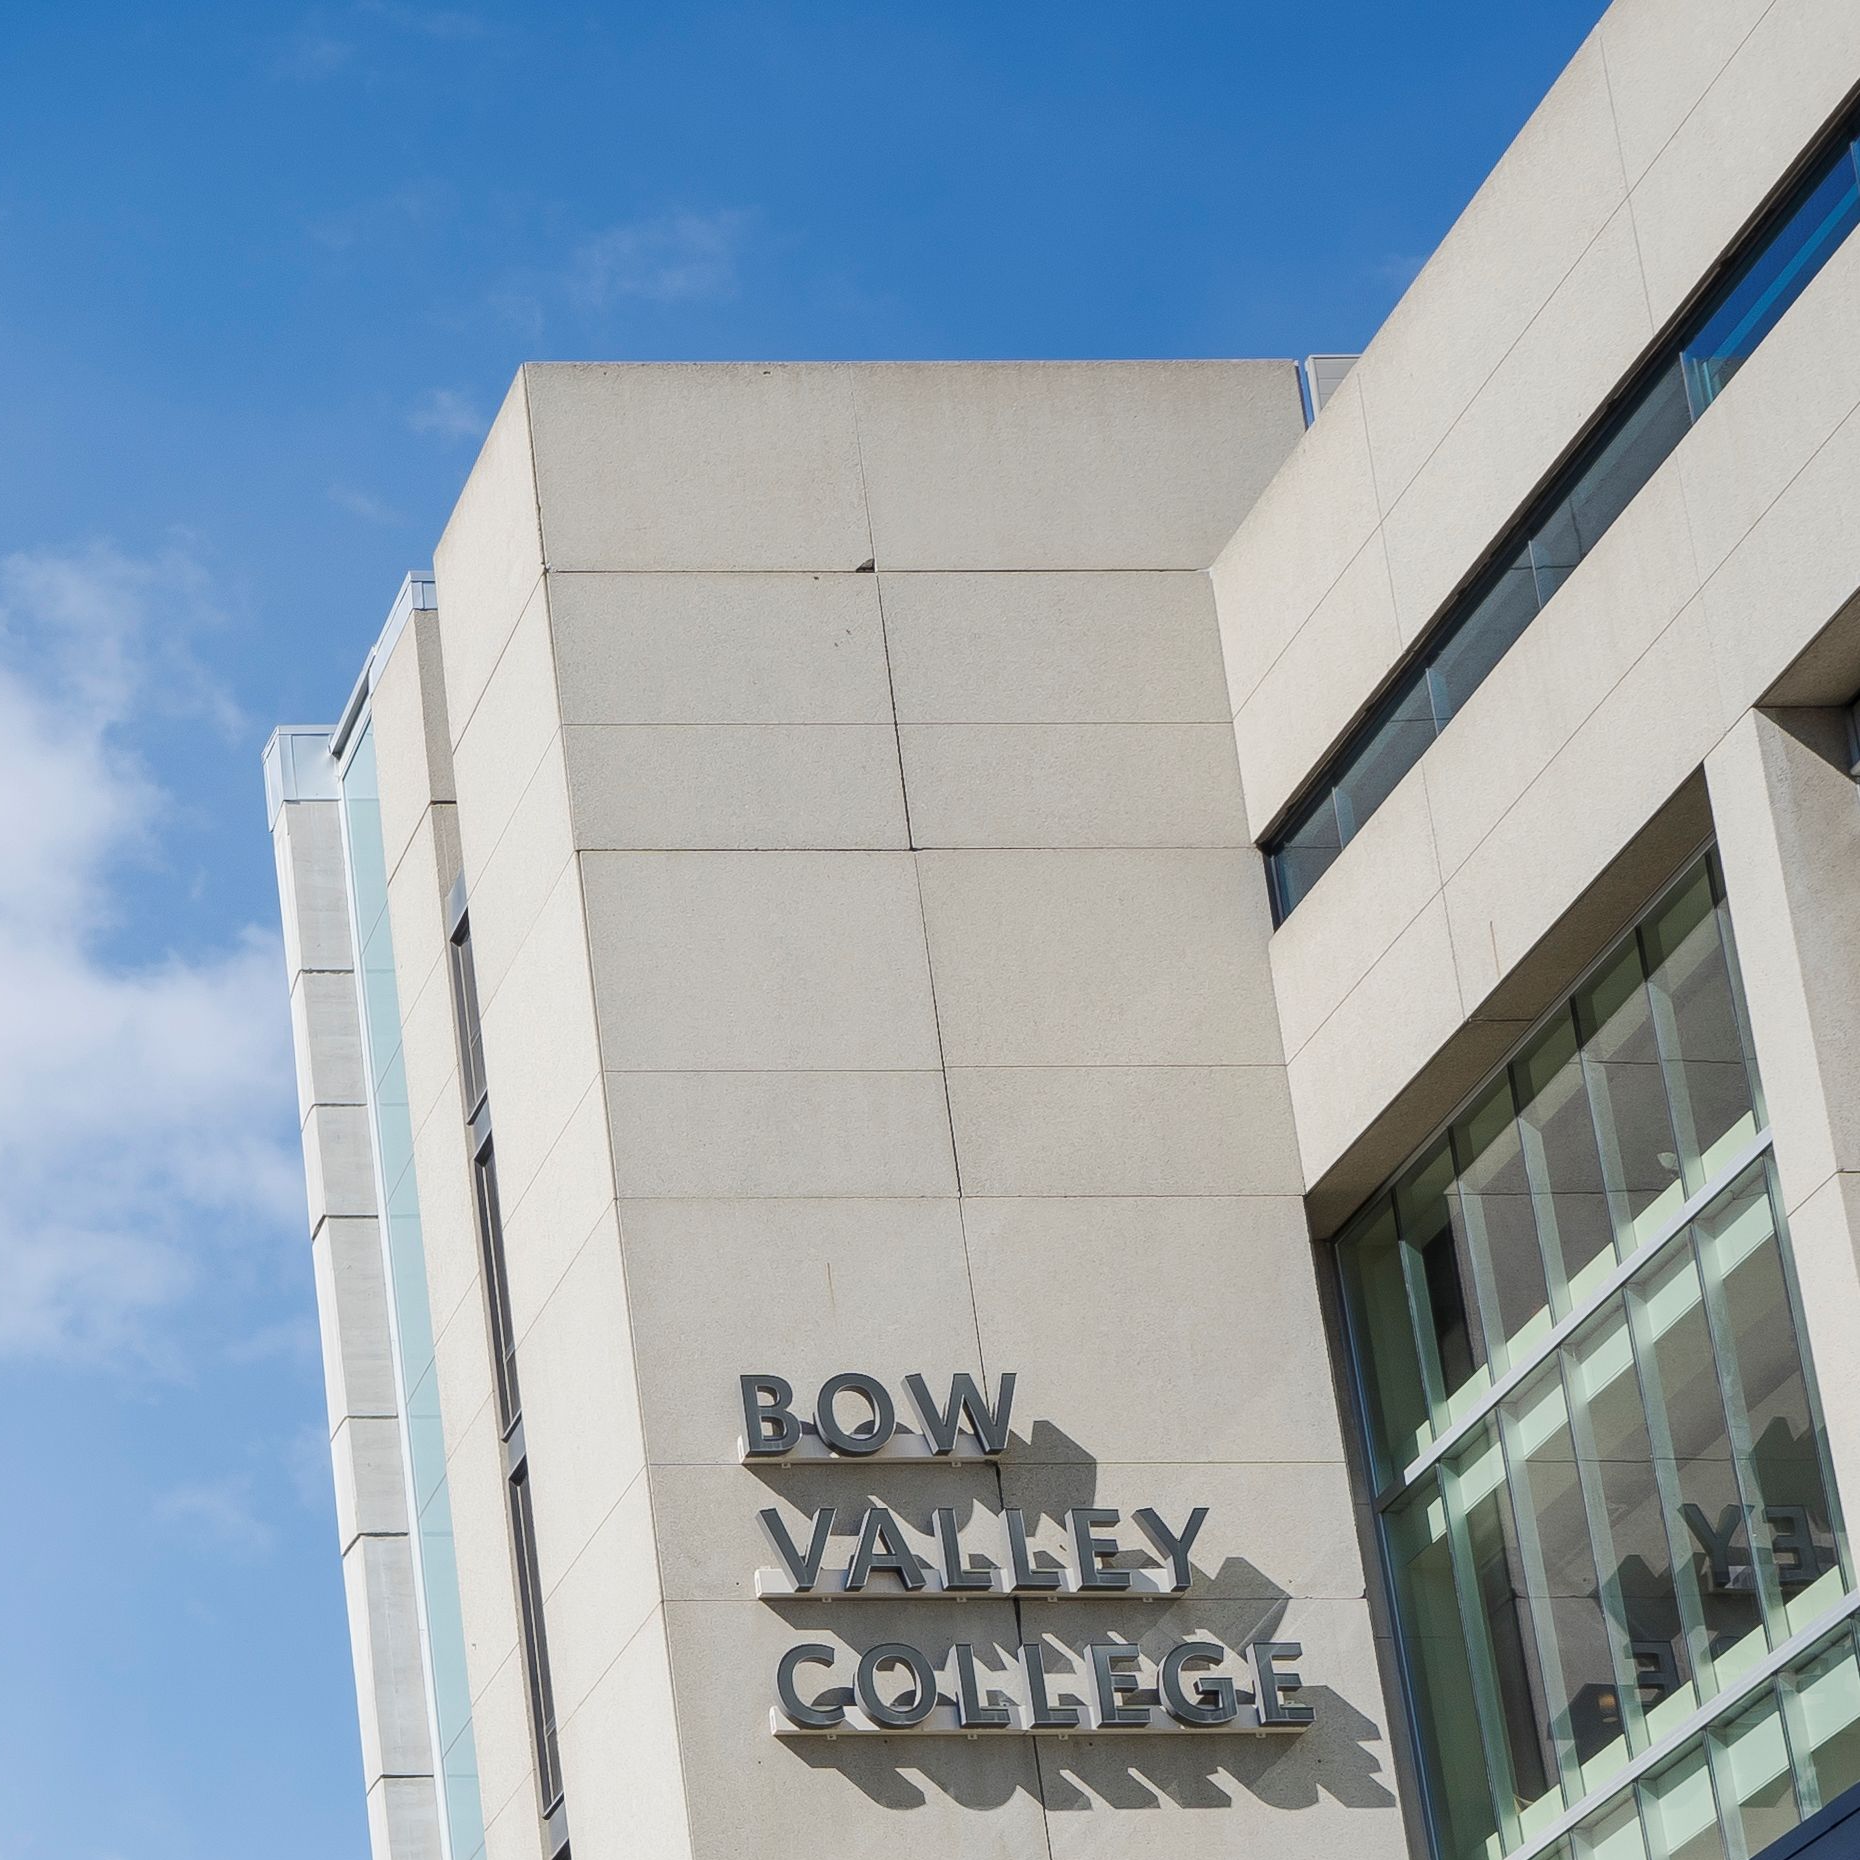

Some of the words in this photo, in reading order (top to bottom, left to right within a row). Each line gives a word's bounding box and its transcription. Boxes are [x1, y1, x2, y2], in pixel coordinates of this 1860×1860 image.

[739, 1372, 1017, 1457] BOW
[756, 1507, 1209, 1591] VALLEY
[775, 1642, 1315, 1729] COLLEGE
